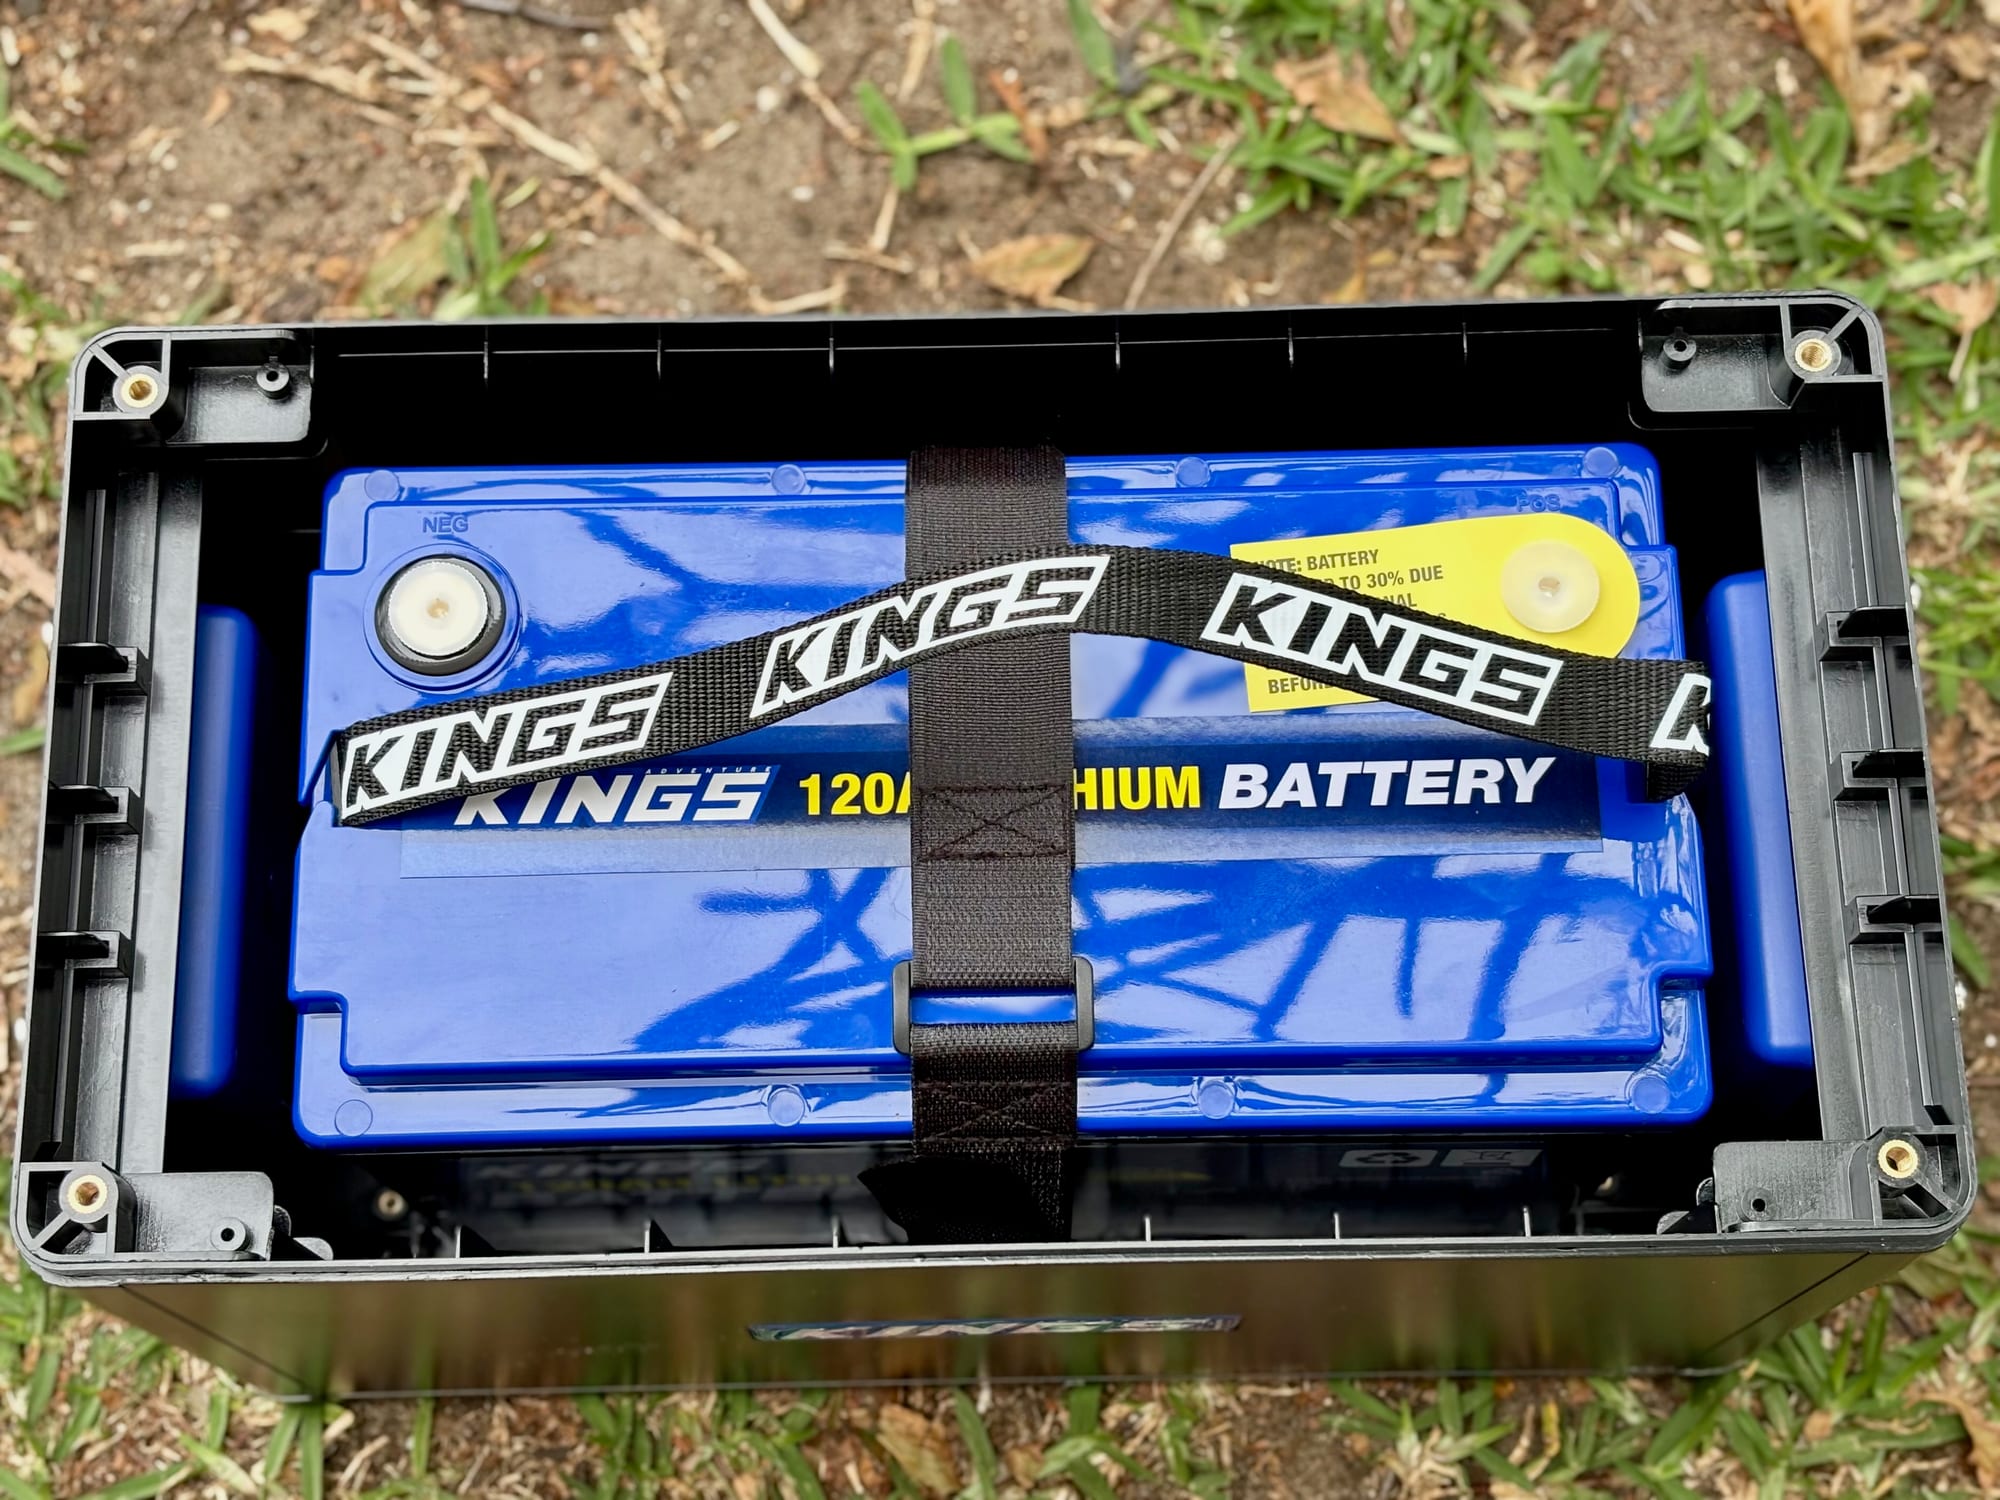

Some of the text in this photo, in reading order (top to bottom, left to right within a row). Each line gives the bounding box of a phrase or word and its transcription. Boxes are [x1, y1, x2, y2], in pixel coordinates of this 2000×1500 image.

[1516, 488, 1561, 513] POS
[423, 516, 468, 533] NEG
[1259, 549, 1379, 573] OTE: BATTERY
[1339, 575, 1361, 590] TO
[1366, 570, 1404, 589] 30%
[1409, 565, 1444, 584] DUE
[750, 555, 1111, 719] KINGS
[1201, 572, 1564, 726] KINGS
[341, 672, 674, 819] KINGS
[645, 766, 772, 775] ADVENTURE
[453, 772, 770, 826] KINGS
[1073, 765, 1200, 810] HIUM
[1218, 757, 1556, 809] BATTERY
